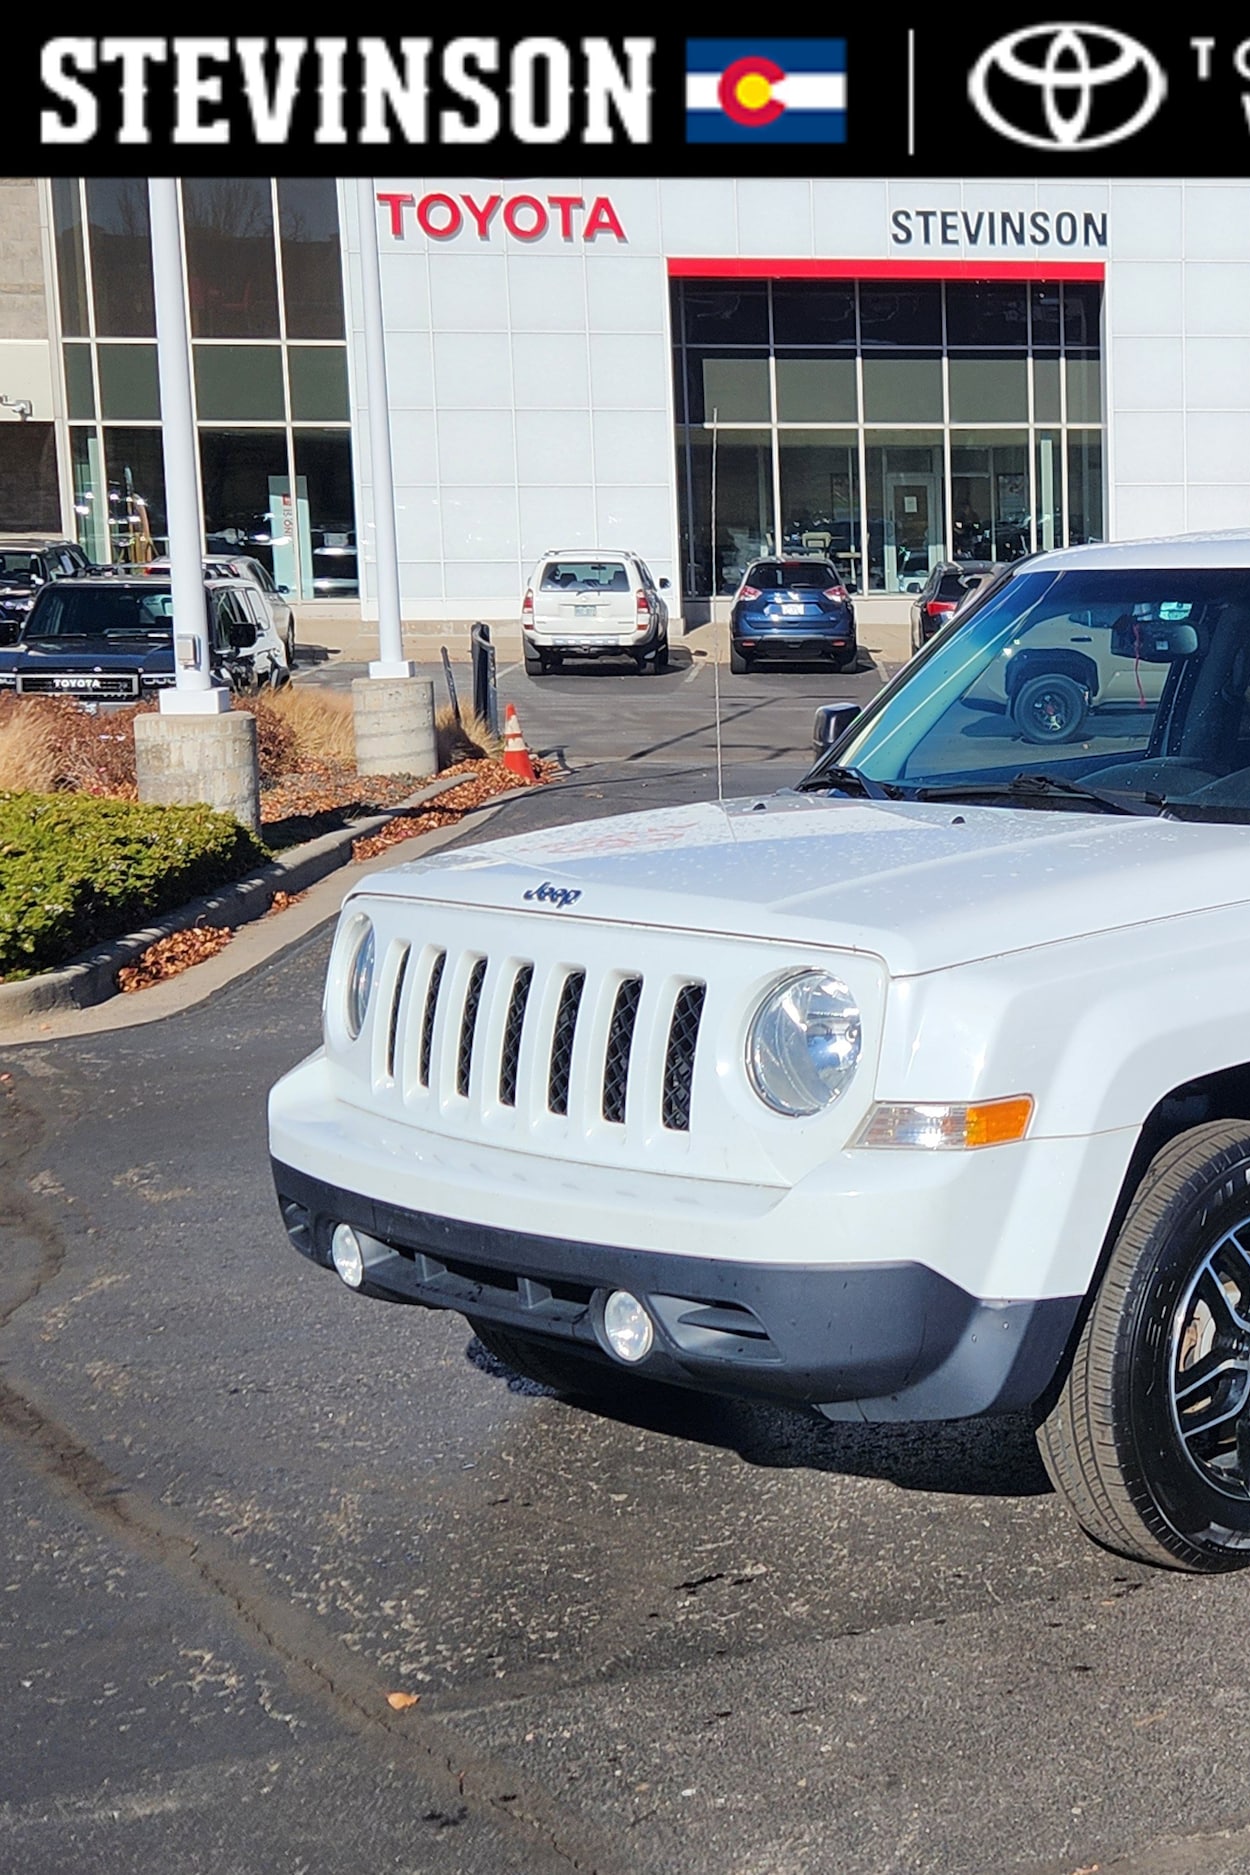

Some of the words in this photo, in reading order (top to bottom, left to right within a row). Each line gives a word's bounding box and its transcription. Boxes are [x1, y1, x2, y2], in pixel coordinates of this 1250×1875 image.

[376, 192, 627, 242] TOYOTA
[891, 210, 1108, 246] STEVINSON
[53, 678, 101, 688] TOYOTA
[523, 881, 582, 909] Jeep
